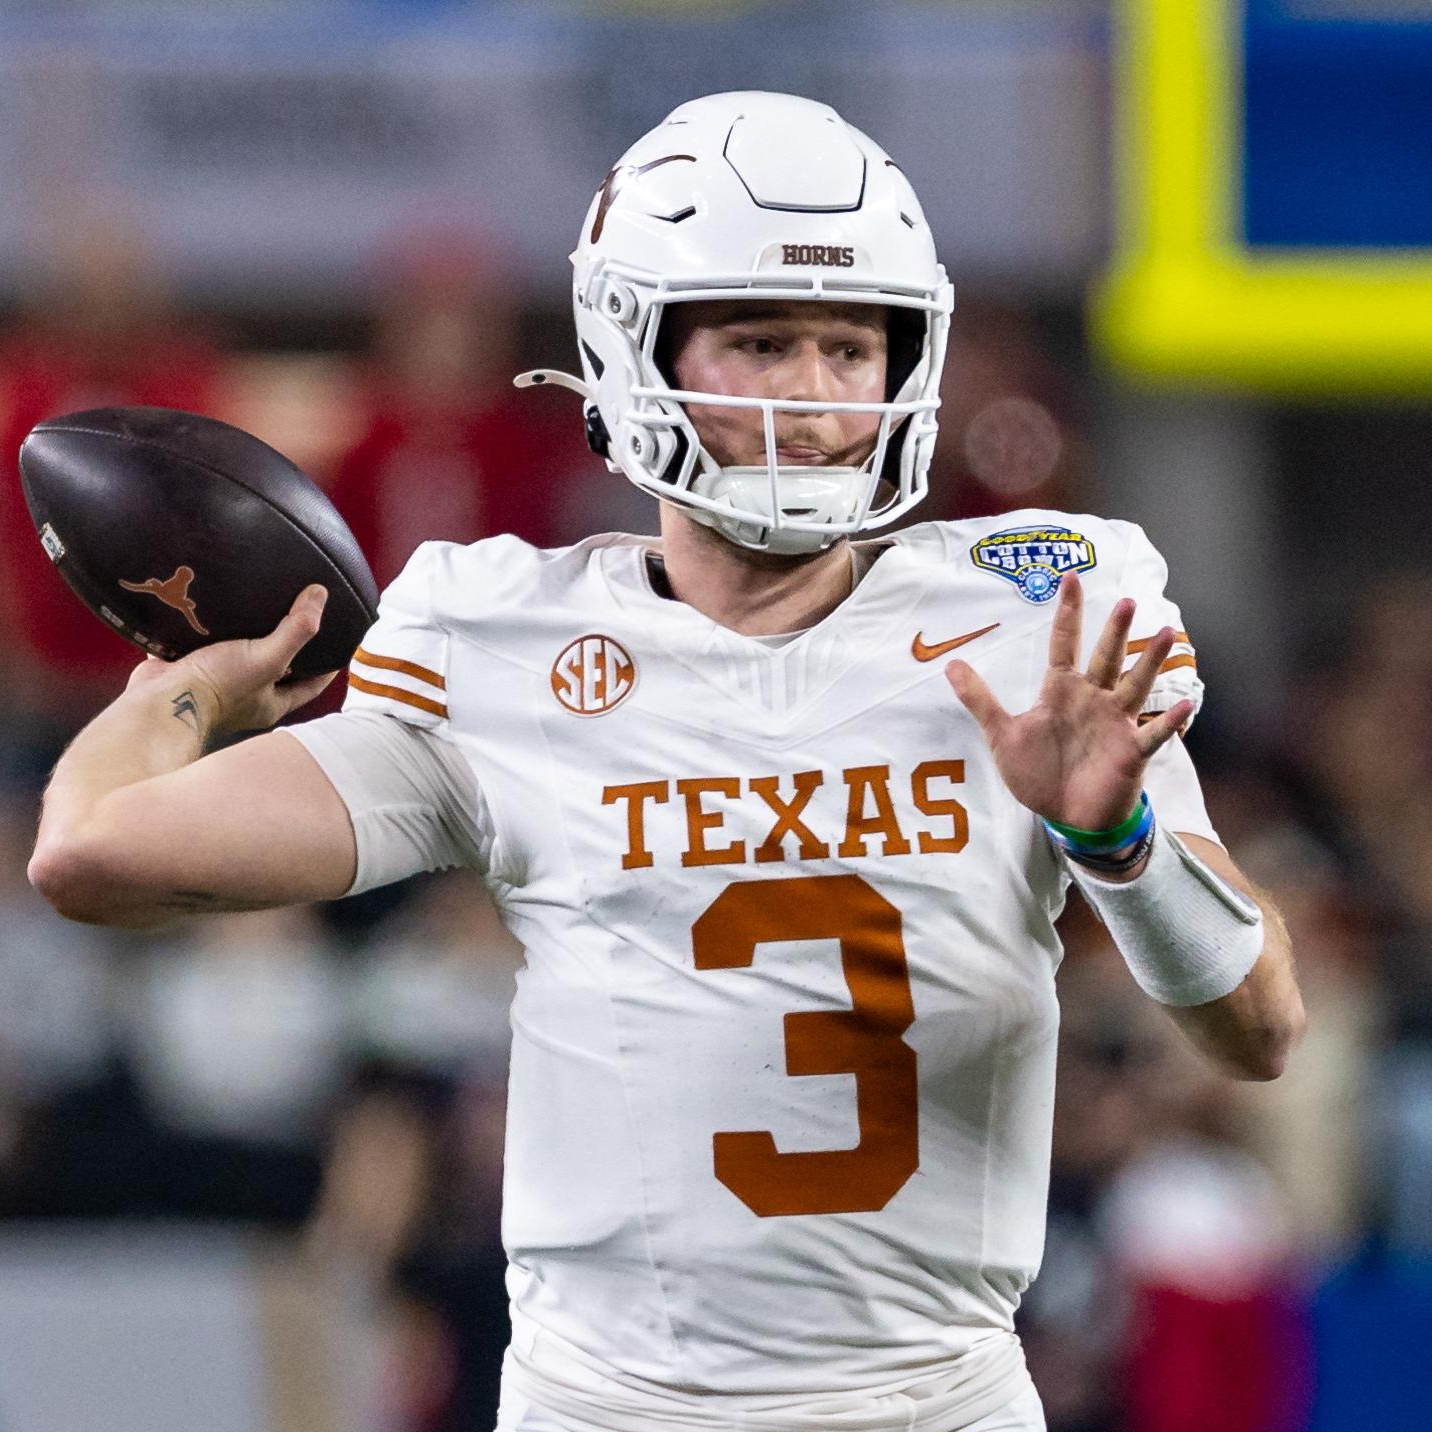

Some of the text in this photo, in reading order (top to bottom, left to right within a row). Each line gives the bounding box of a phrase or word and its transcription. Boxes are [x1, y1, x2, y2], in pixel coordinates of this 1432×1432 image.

[782, 244, 854, 267] HORNS
[979, 541, 1089, 567] COTTON
[1001, 555, 1070, 571] BOWL
[555, 638, 630, 711] SEC
[601, 759, 969, 870] TEXAS
[691, 873, 920, 1218] 3
